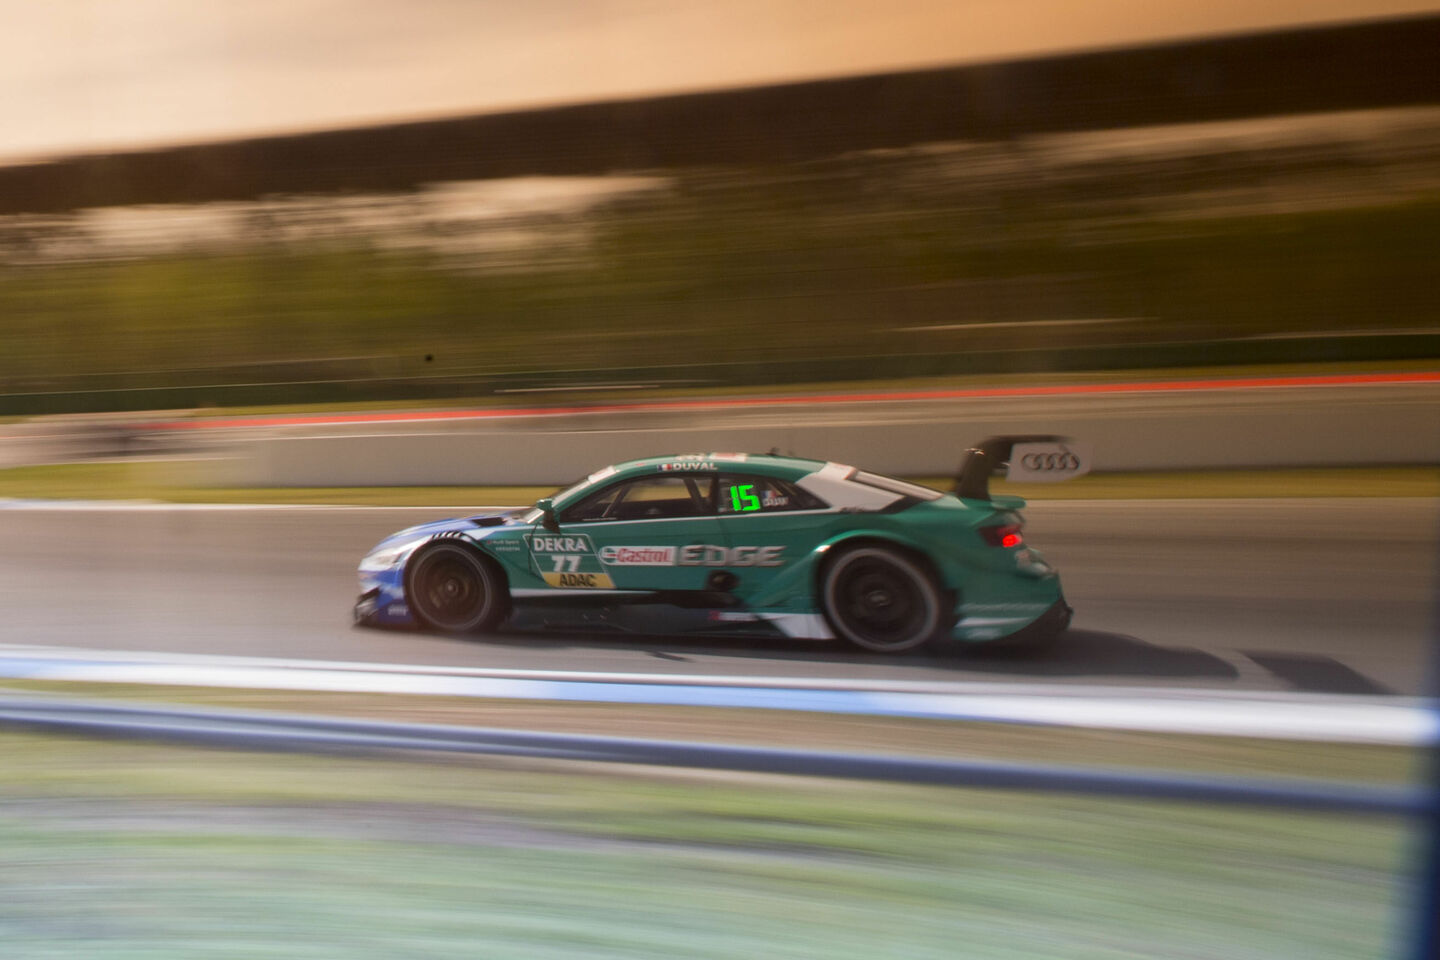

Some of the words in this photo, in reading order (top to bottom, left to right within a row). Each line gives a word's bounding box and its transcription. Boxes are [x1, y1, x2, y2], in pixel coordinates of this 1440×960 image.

[673, 462, 718, 471] DUVAL
[730, 484, 760, 511] 15
[533, 538, 588, 552] DEKRA
[617, 548, 668, 563] Castrol
[678, 545, 787, 566] EDGE
[551, 555, 582, 572] 77
[559, 574, 596, 587] ADAC
